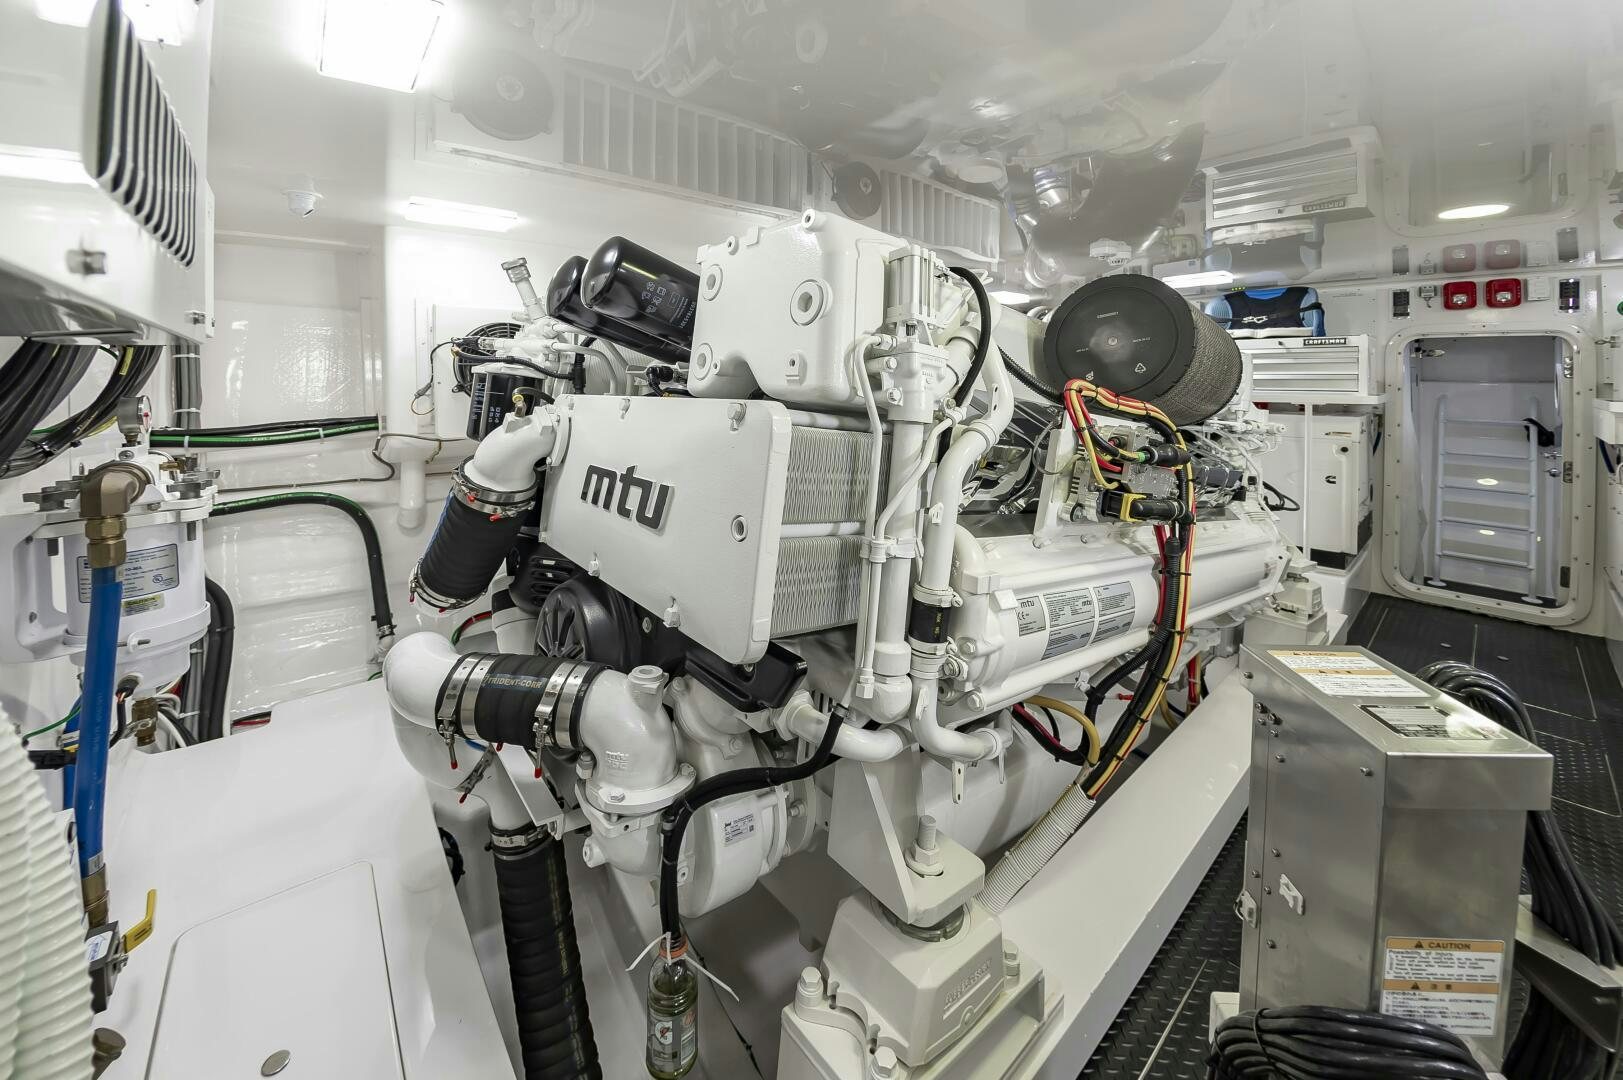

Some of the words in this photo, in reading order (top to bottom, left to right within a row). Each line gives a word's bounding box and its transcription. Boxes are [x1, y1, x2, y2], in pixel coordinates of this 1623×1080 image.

[580, 464, 669, 529] mtu
[1020, 599, 1035, 608] mtu
[1428, 941, 1472, 950] CAUTION
